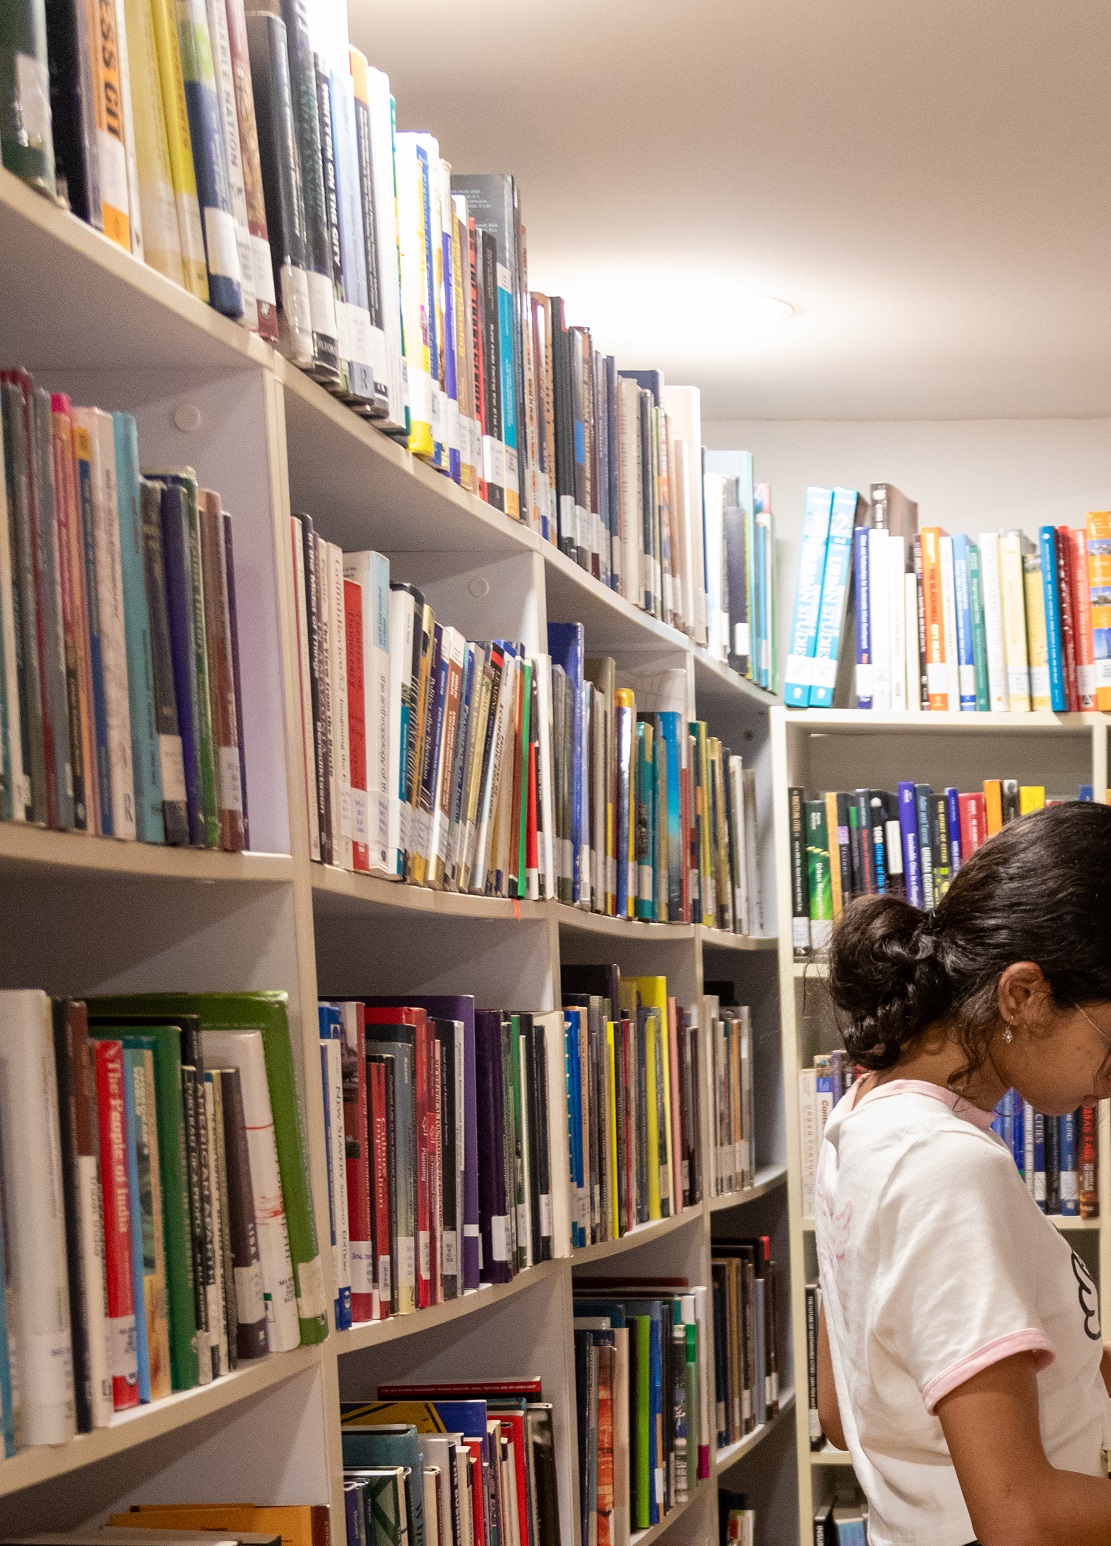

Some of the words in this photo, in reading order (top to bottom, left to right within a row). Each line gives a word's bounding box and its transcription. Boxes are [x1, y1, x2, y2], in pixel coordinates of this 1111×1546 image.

[931, 640, 941, 663] READE
[874, 826, 882, 844] 100
[922, 847, 931, 872] URBAN
[924, 874, 933, 908] ECOSYST
[107, 1061, 122, 1092] The
